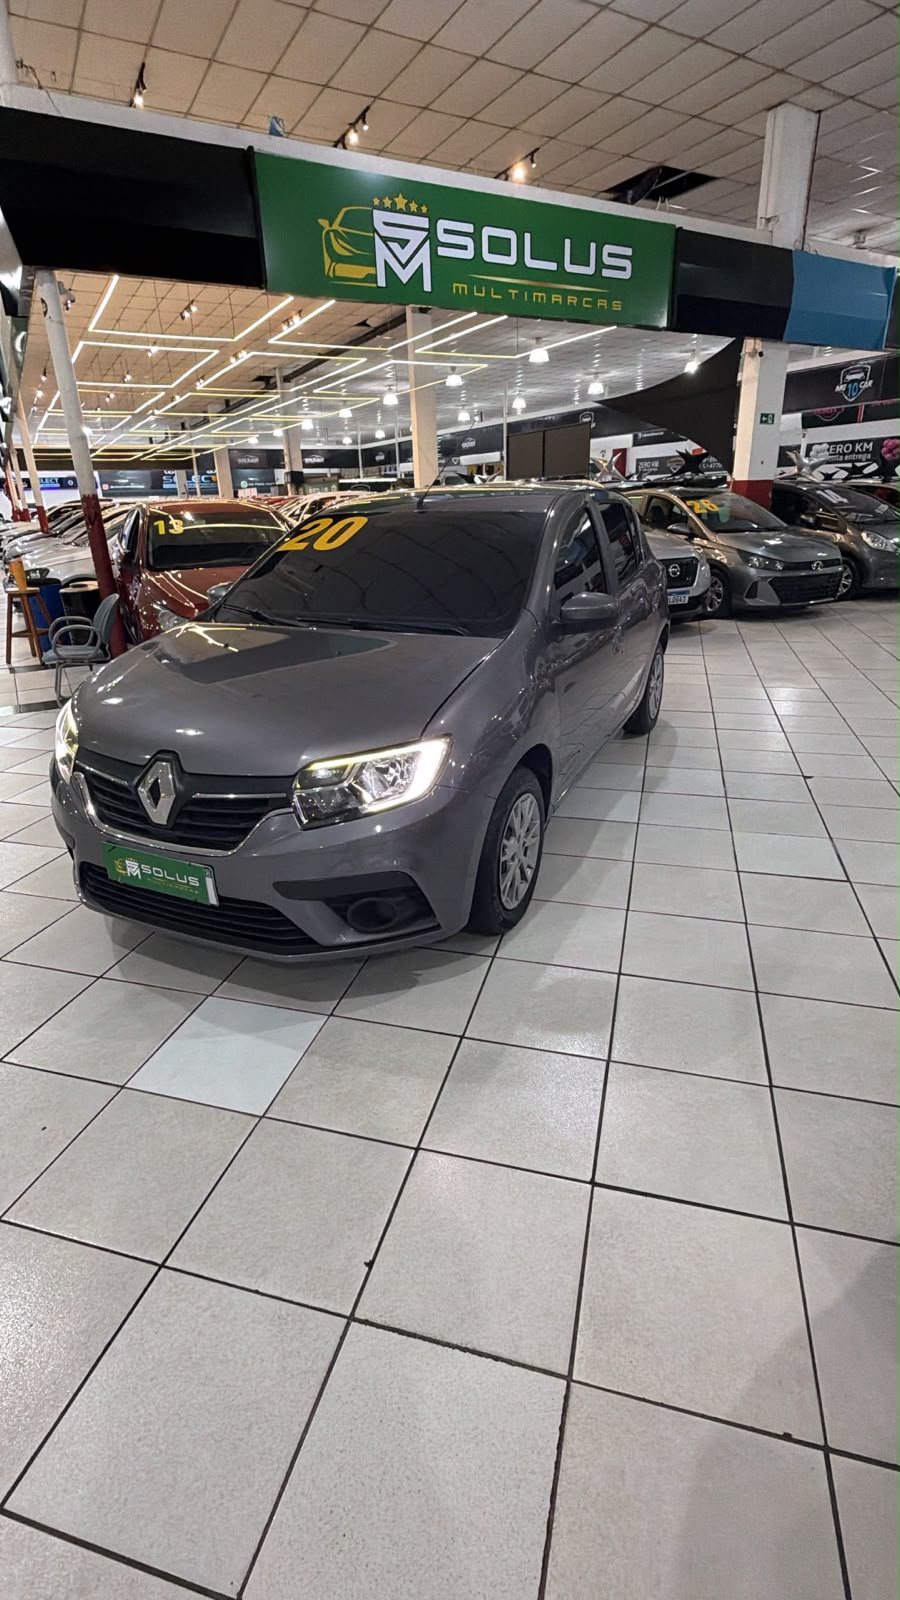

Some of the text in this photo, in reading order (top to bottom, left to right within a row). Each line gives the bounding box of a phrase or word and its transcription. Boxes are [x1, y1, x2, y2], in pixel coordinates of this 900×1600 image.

[436, 219, 634, 281] SOLUS
[452, 282, 623, 312] MULTIMARCAS
[847, 382, 859, 398] 10
[829, 441, 874, 455] ERO KM
[686, 499, 720, 514] 26
[153, 519, 185, 535] 13
[275, 516, 369, 551] 20
[141, 864, 200, 887] SOLUS
